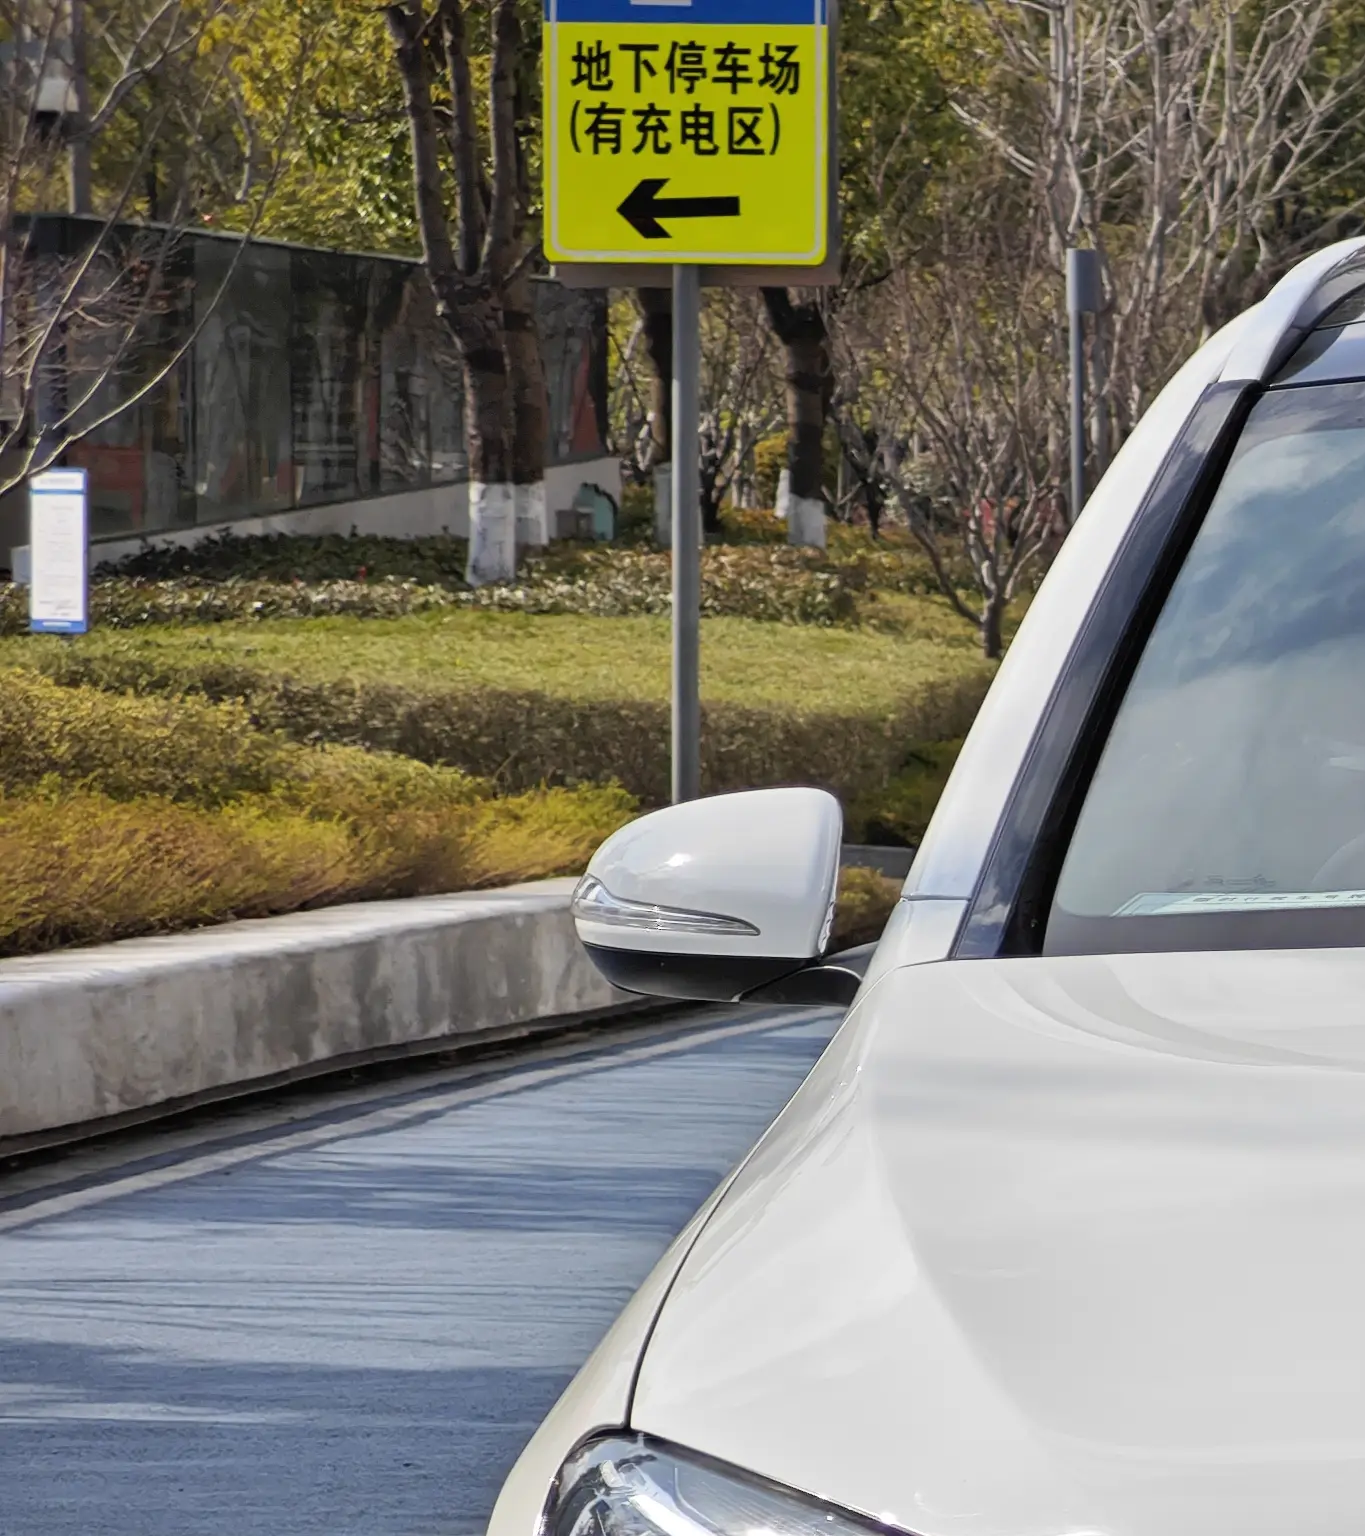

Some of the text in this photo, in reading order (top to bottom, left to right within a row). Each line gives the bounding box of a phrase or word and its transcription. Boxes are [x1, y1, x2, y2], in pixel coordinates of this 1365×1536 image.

[570, 40, 801, 95] 地下停车场
[570, 100, 781, 156] (有充电区)
